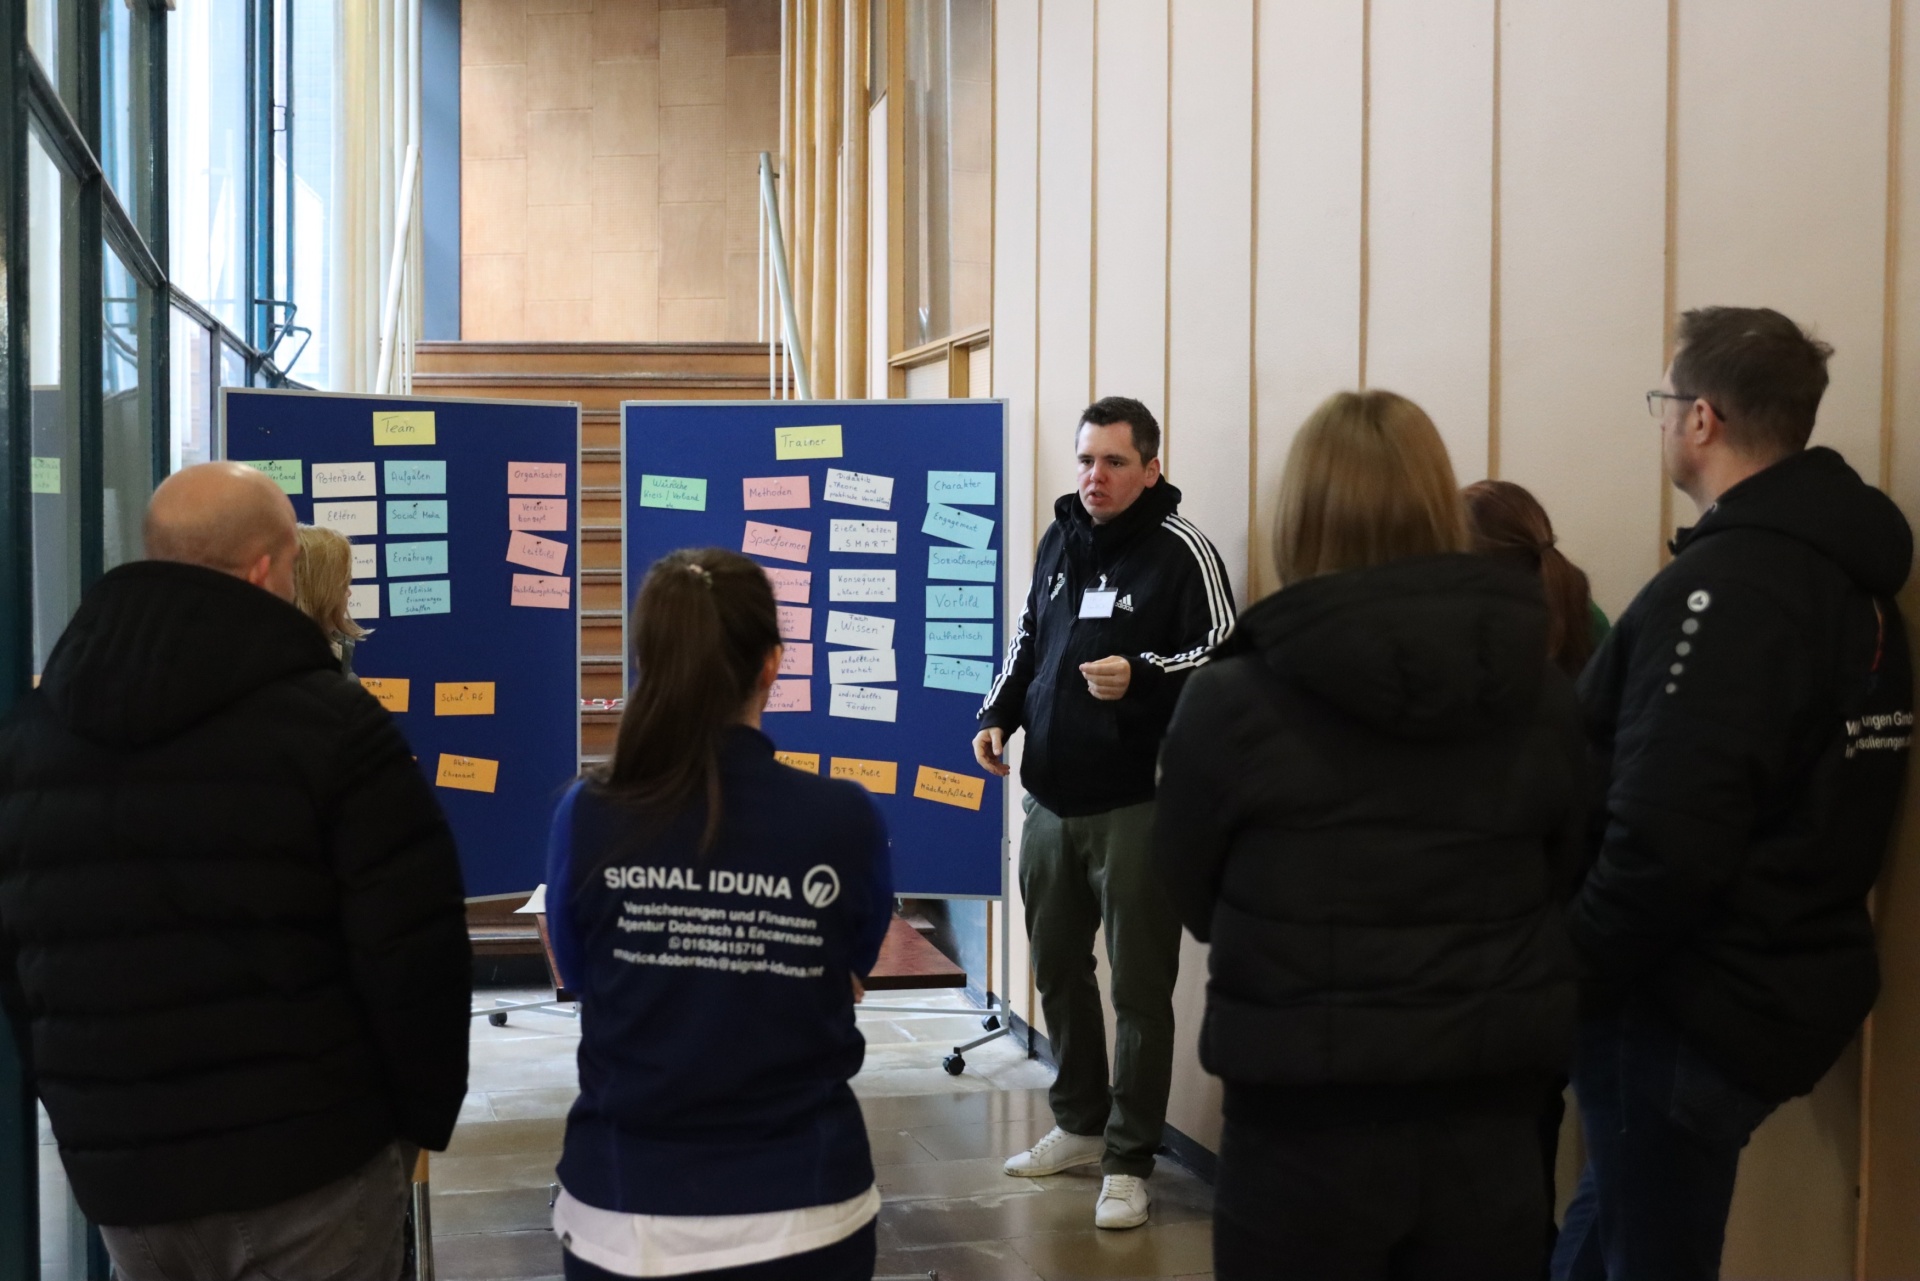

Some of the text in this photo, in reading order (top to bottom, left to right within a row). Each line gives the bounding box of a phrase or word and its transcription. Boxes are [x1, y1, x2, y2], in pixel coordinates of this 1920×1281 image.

[381, 416, 415, 433] Team
[780, 434, 826, 448] Trainer
[315, 472, 366, 484] Potenziale
[391, 472, 431, 486] Aufgaben
[514, 469, 562, 482] Organisation
[652, 478, 689, 491] Wünsche
[934, 479, 981, 491] Charakter
[643, 490, 662, 499] Kreis
[750, 488, 792, 498] Methoden
[327, 510, 356, 521] Eltern
[391, 509, 416, 520] Social
[933, 512, 978, 532] Engagement
[750, 529, 807, 550] Spielformen
[935, 593, 980, 608] Vorbild
[928, 631, 983, 641] Authentisch
[604, 866, 792, 899] SIGNAL IDUNA
[623, 901, 817, 930] Versicherungen und Finanzen
[617, 917, 665, 933] Agentur
[734, 927, 745, 938] &
